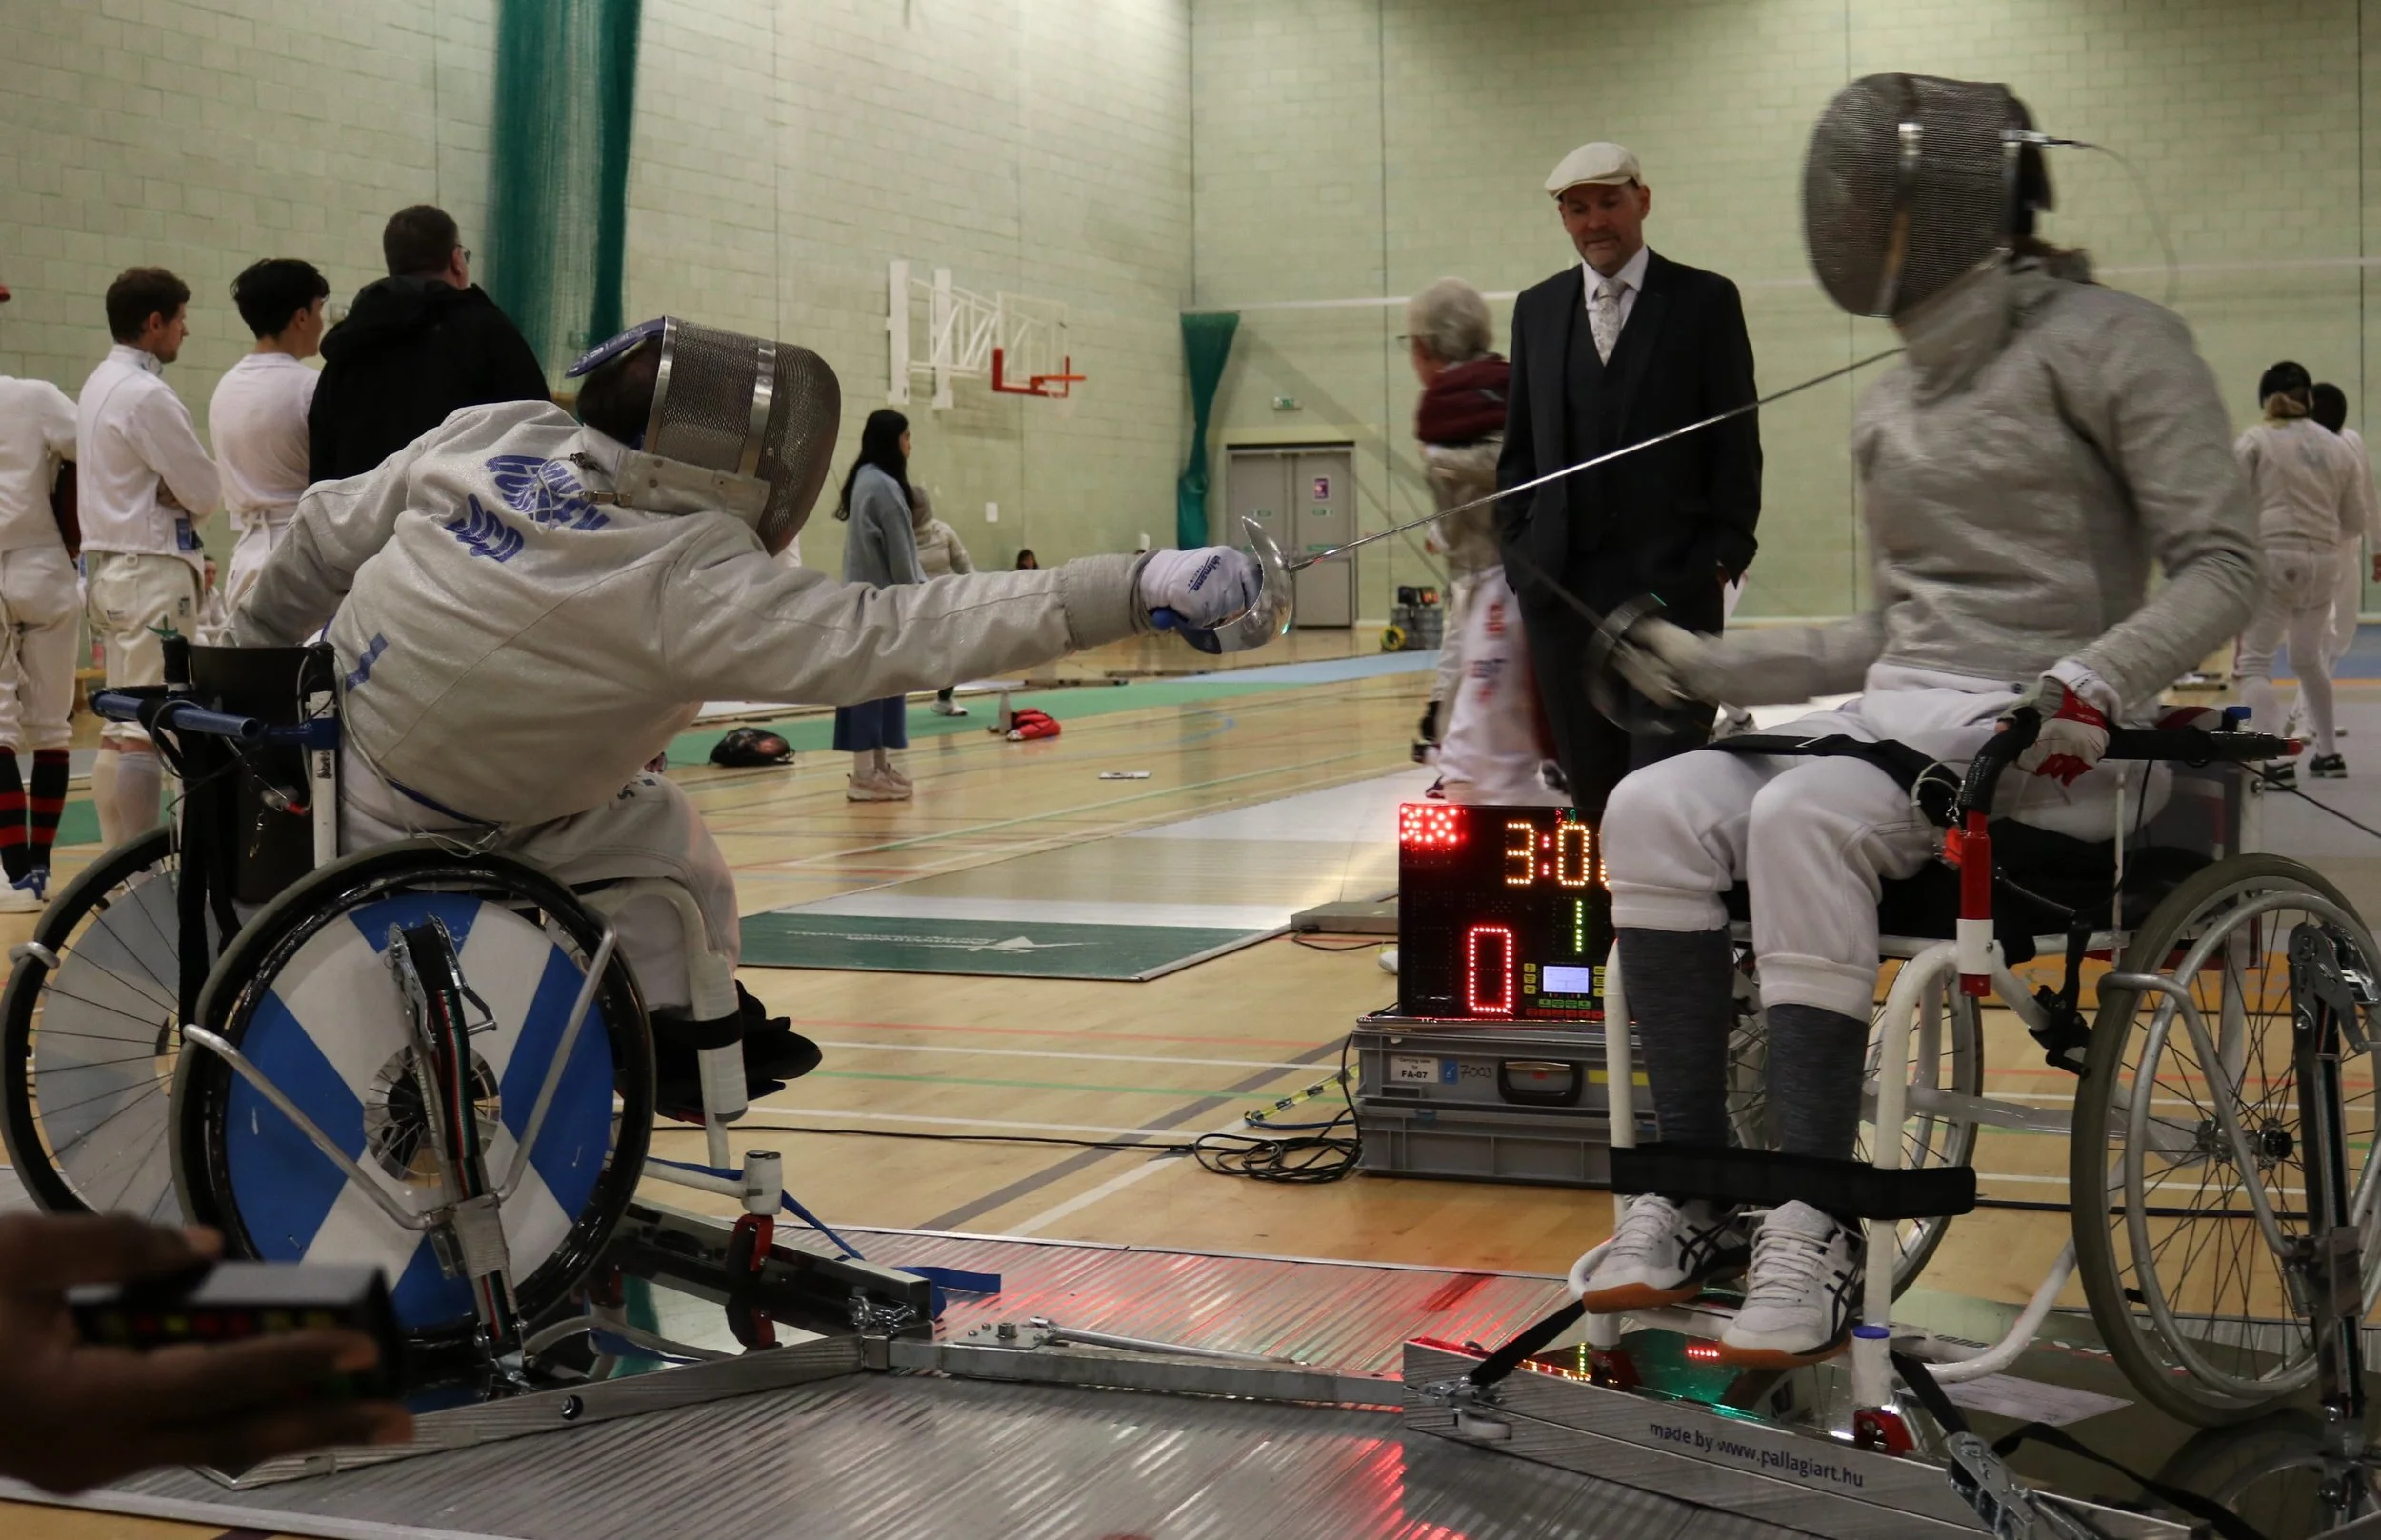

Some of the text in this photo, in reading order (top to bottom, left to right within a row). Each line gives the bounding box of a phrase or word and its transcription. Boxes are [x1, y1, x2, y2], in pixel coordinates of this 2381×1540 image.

[1193, 555, 1221, 591] uhlmann
[1507, 823, 1611, 887] 3:0
[1575, 900, 1583, 952] 1
[1469, 927, 1512, 1013] 0
[1401, 1070, 1428, 1079] FA-07
[1460, 1065, 1492, 1079] 7003
[1650, 1423, 1864, 1488] made by www.pallagiart.hu
